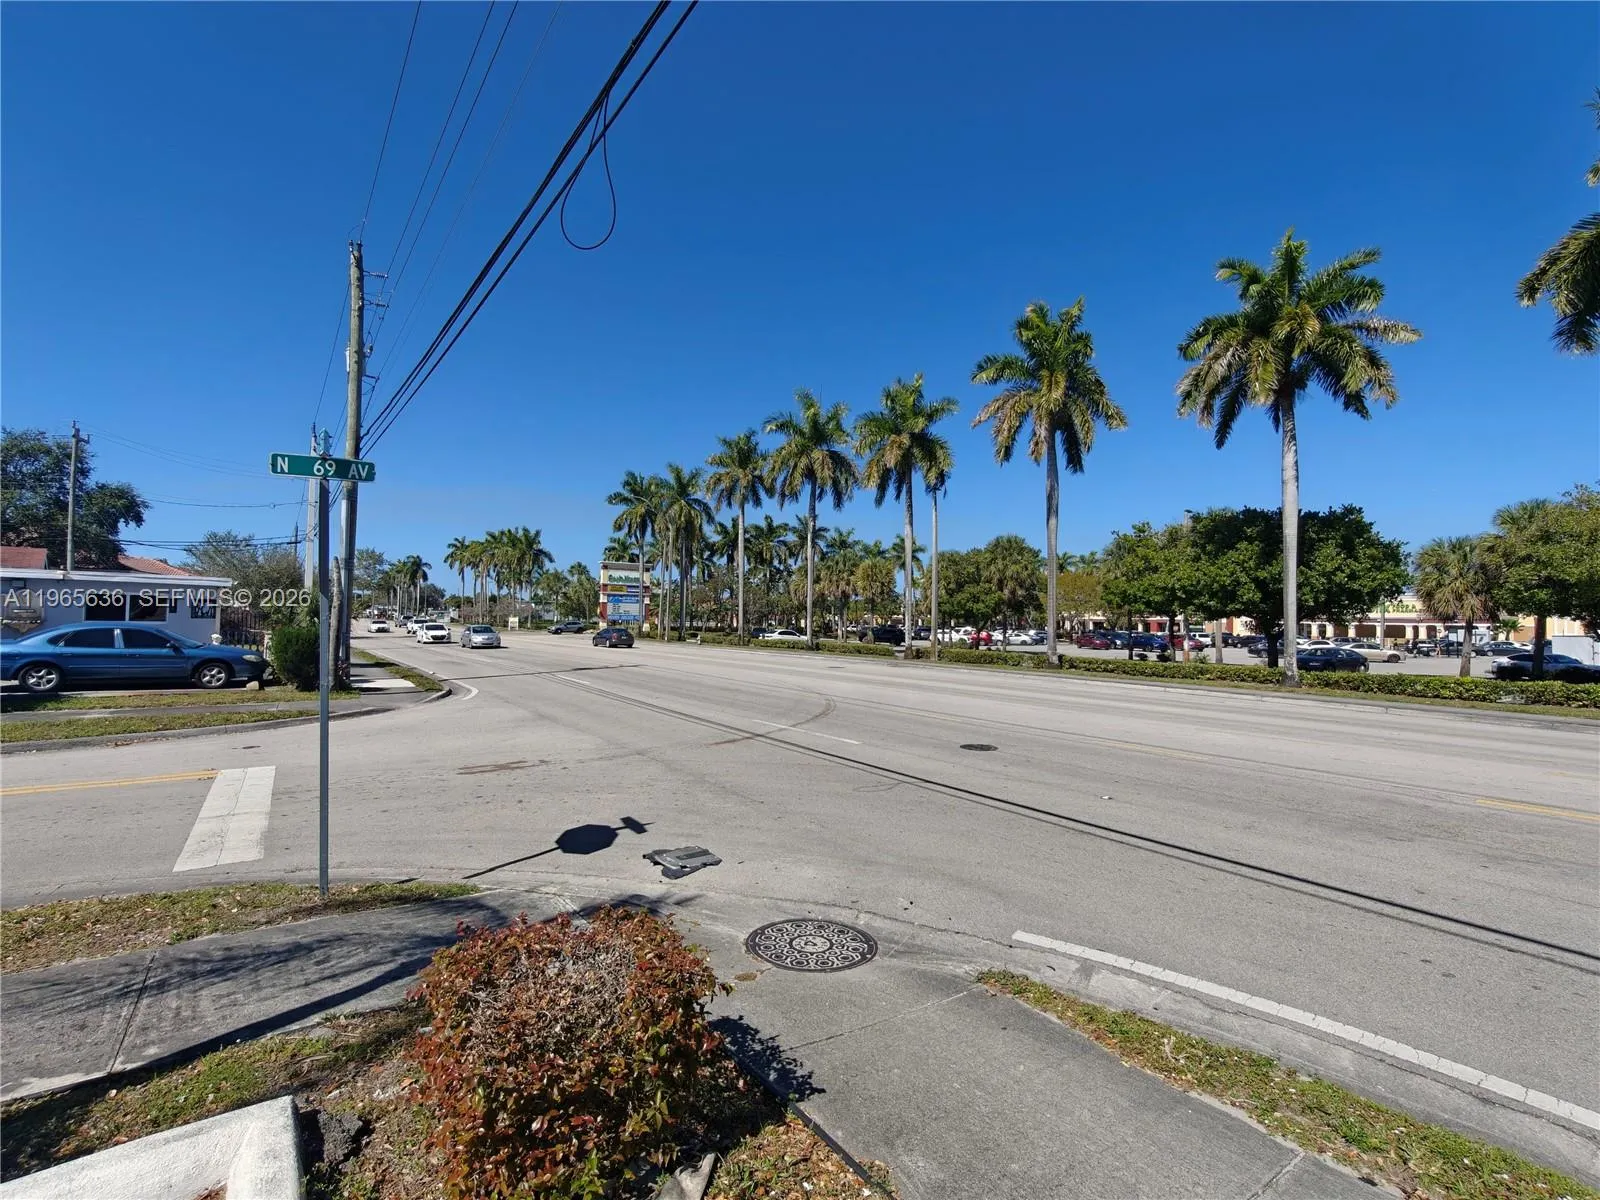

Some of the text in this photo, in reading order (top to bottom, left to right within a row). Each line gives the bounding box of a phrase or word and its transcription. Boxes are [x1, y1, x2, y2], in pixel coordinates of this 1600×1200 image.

[277, 456, 369, 479] N 69 AV
